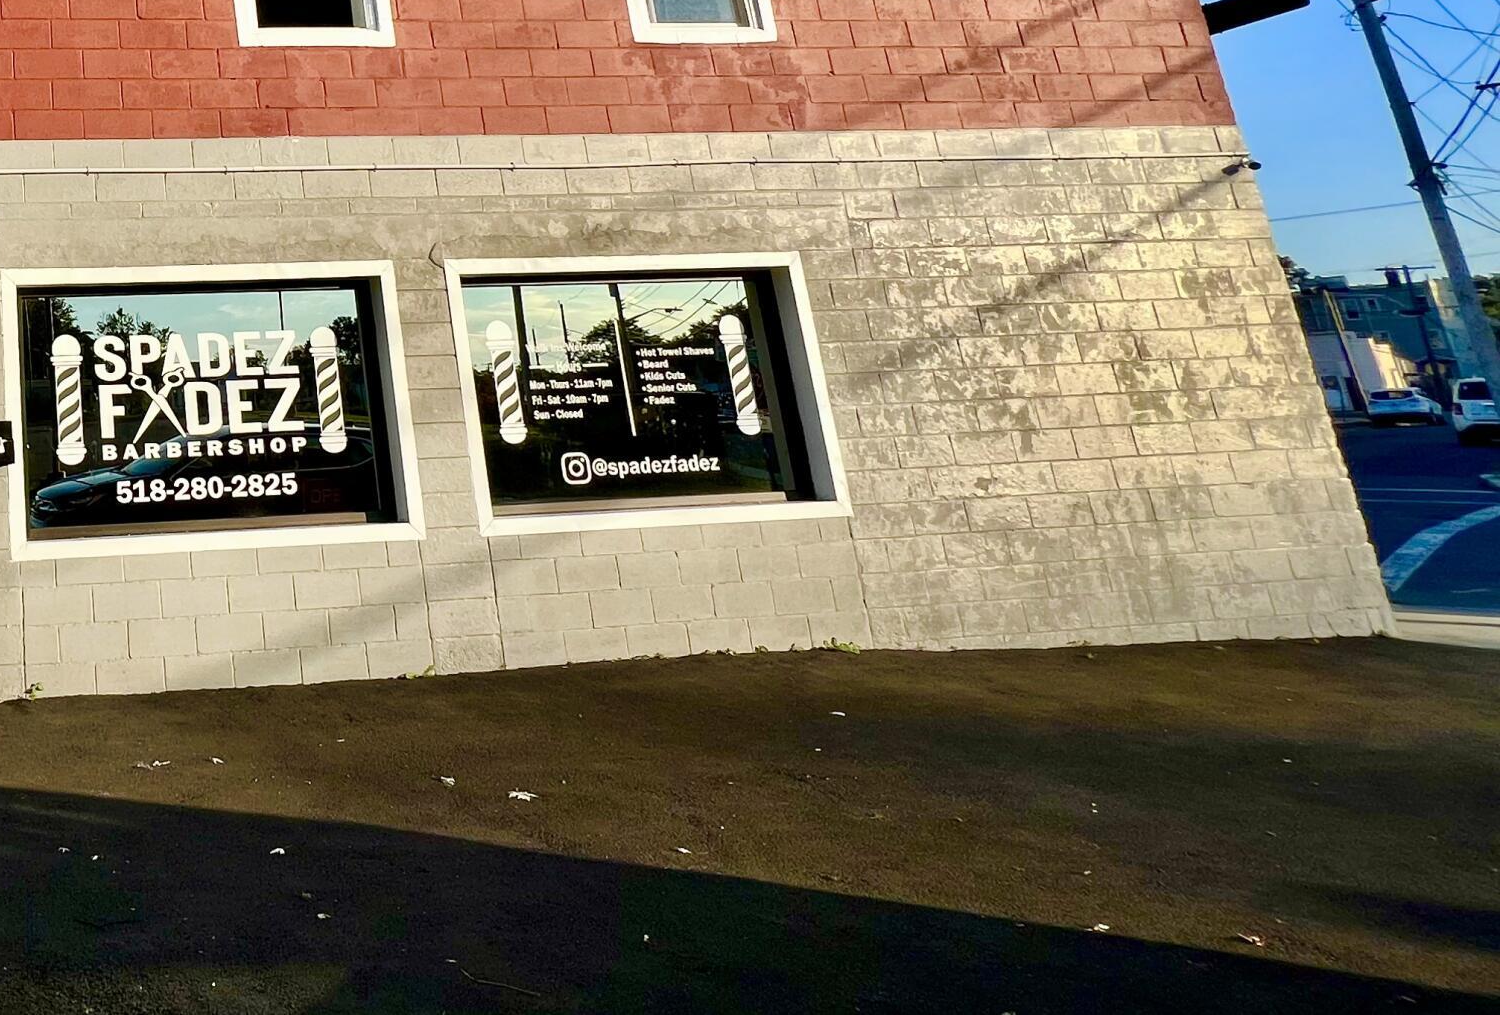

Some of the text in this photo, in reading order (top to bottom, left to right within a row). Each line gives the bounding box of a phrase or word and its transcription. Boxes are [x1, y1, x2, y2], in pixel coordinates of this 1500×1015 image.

[93, 330, 300, 382] SPADEZ
[640, 346, 714, 357] Hot Towel Shaves
[556, 361, 582, 374] Hours
[642, 359, 669, 369] Beard
[644, 370, 686, 381] Kids Cuts
[646, 382, 697, 393] Senior Cuts
[648, 395, 675, 405] Fadez
[533, 410, 550, 420] Sun
[555, 408, 584, 419] Closed
[102, 436, 307, 461] BARBERSHOP
[592, 454, 721, 479] @spadezfadez
[116, 472, 299, 503] 518-280-2825
